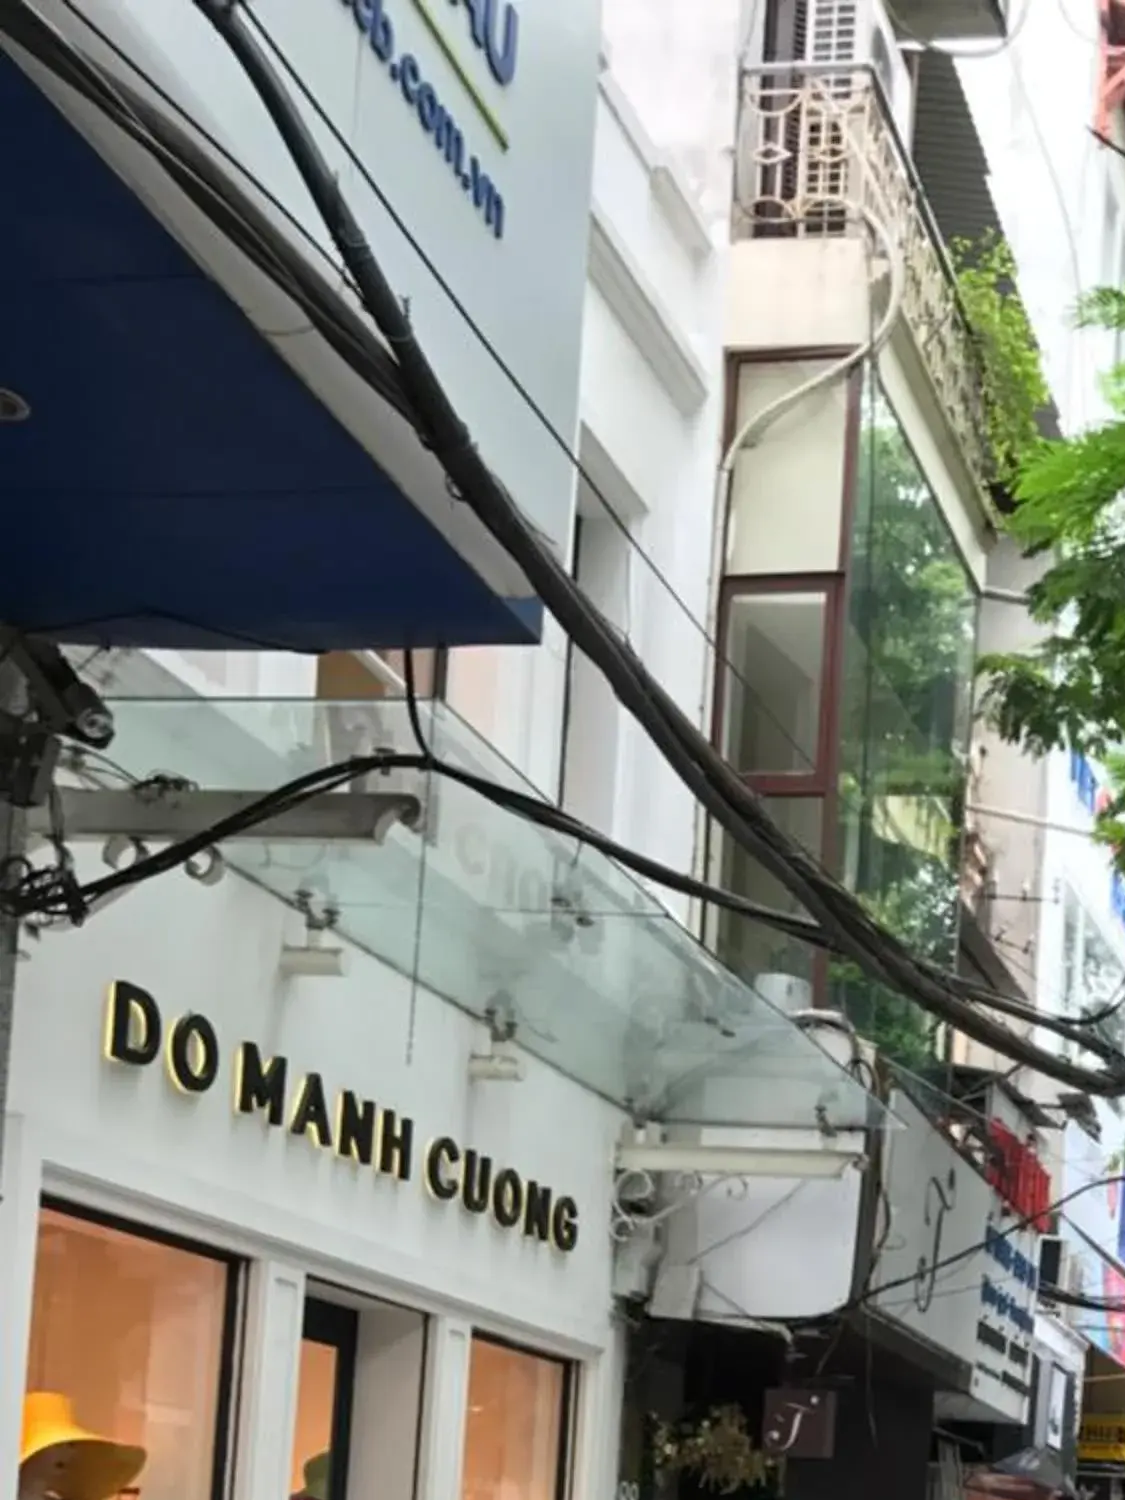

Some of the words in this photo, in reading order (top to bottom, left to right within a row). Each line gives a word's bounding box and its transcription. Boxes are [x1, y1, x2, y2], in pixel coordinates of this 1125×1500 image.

[341, 0, 505, 239] eb.com.vn
[104, 979, 219, 1094] DO
[234, 1041, 413, 1181] MANH
[425, 1136, 578, 1252] CUONG
